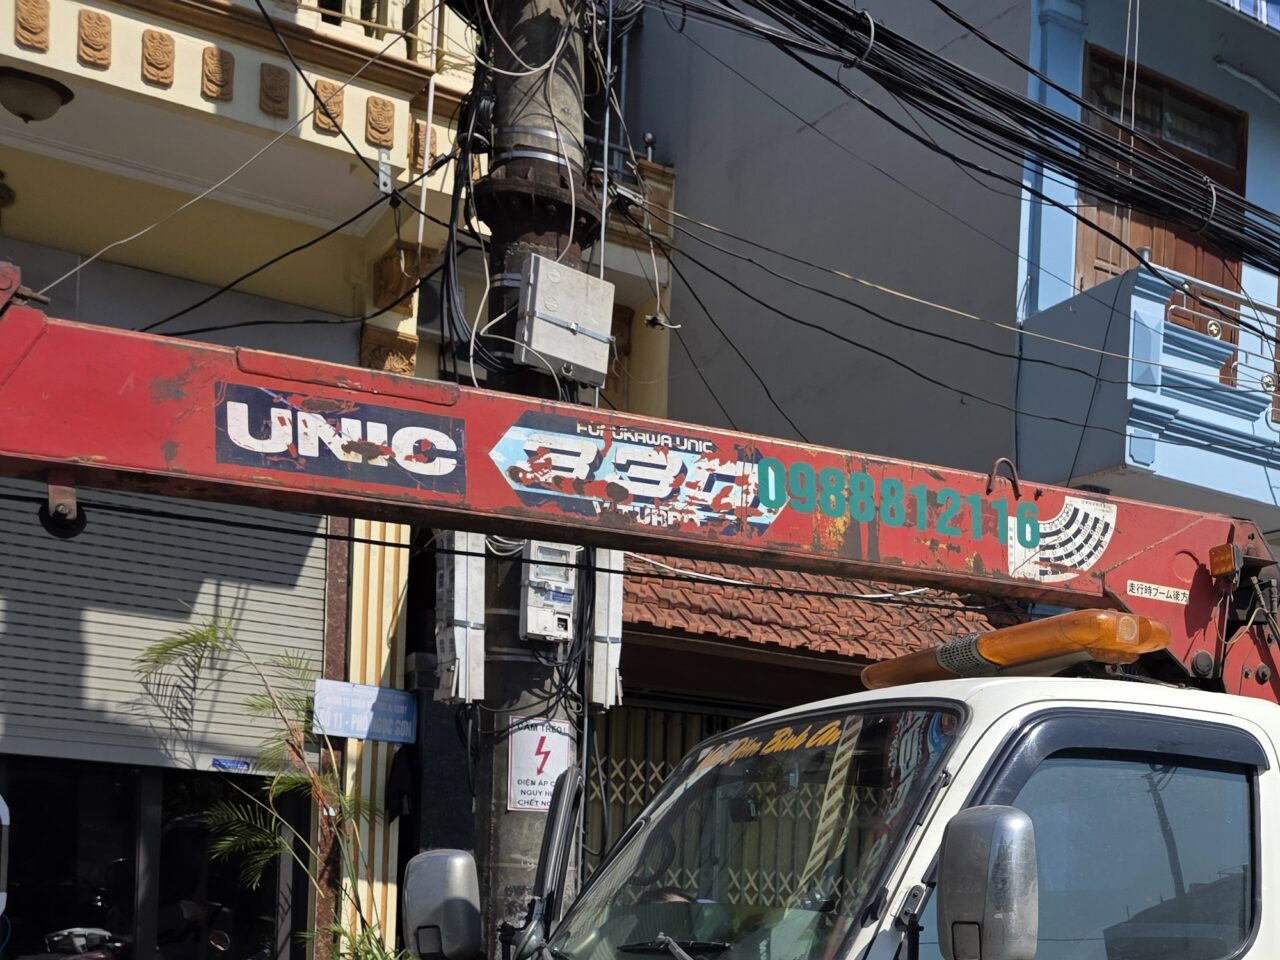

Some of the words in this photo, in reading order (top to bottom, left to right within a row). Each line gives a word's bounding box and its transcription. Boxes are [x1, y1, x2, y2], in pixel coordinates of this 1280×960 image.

[227, 400, 458, 477] UNIC
[675, 437, 714, 453] UNIC
[757, 456, 1040, 549] 0988812116
[517, 778, 536, 786] ĐIỆN
[520, 789, 543, 797] NGUY
